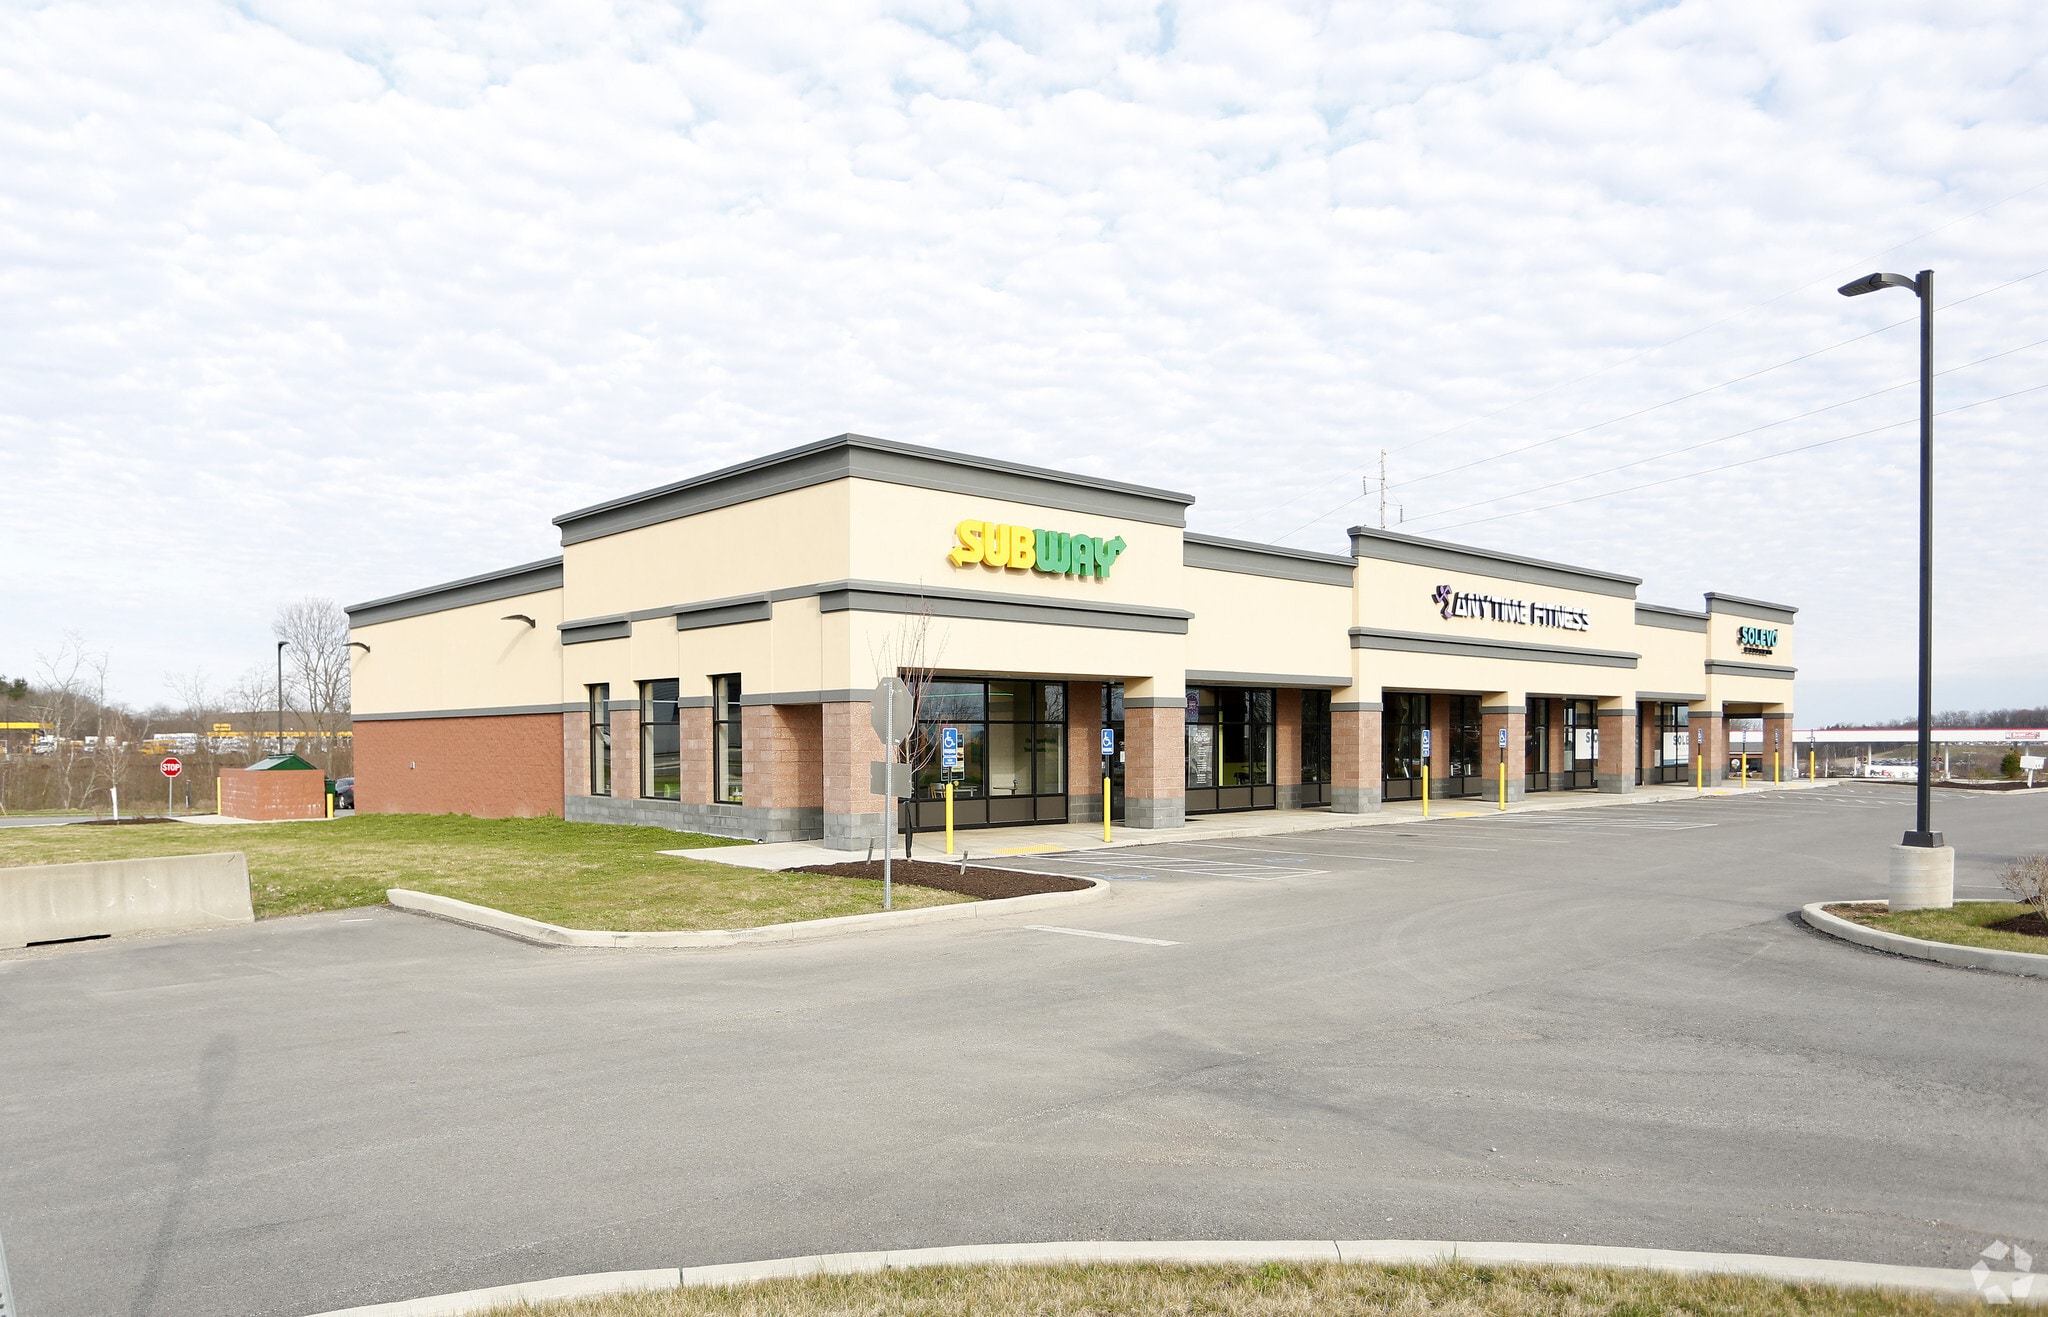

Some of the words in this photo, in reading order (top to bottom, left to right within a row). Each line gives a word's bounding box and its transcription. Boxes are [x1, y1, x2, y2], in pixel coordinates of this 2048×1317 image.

[949, 519, 1127, 577] SUBWAY
[1451, 592, 1531, 624] ANYTIME
[1531, 602, 1591, 631] FITNESS
[1740, 626, 1778, 647] SOLEVO
[162, 763, 180, 771] STOP
